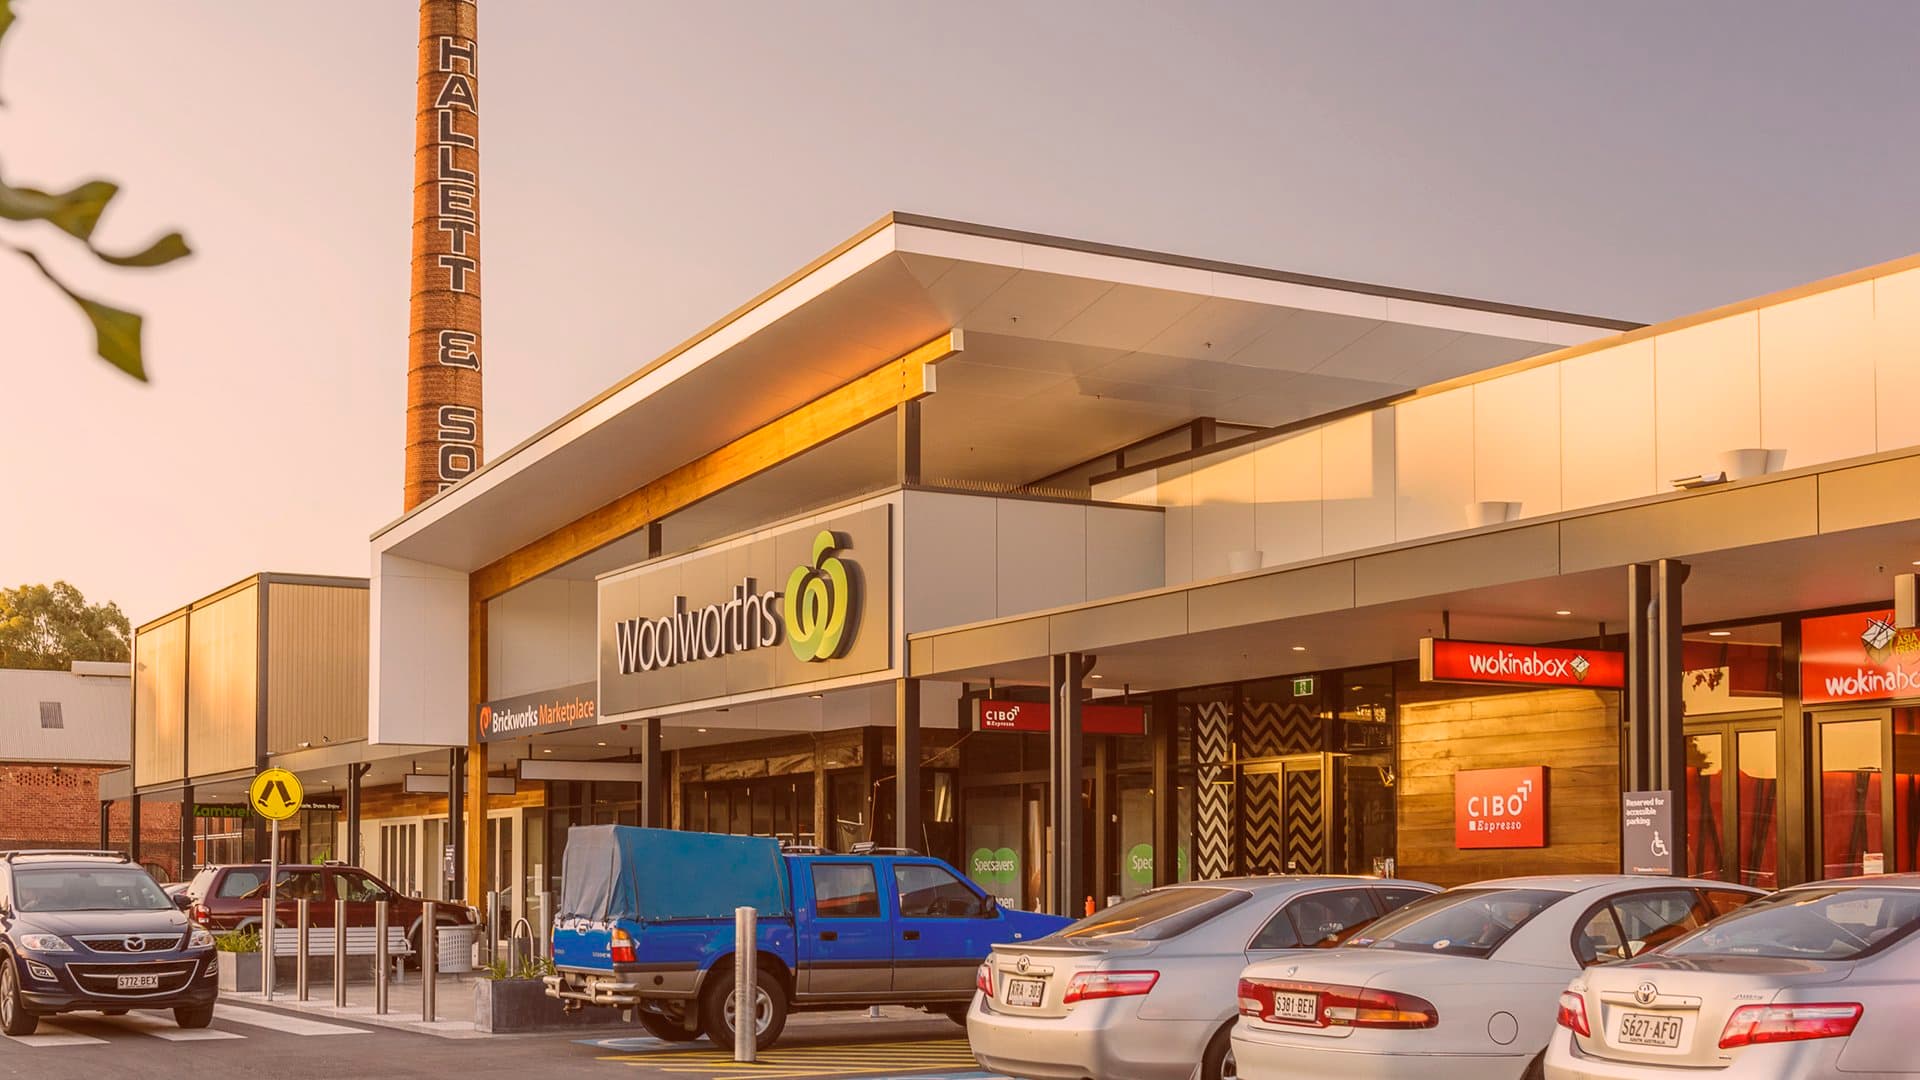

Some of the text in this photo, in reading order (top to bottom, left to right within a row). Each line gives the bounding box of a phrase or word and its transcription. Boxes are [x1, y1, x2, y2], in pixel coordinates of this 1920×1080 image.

[435, 36, 480, 494] HALLETT & SO
[615, 576, 777, 675] woolworths
[1897, 632, 1918, 645] ASIA
[1469, 649, 1569, 678] wokinabox
[492, 696, 595, 733] Brickworks Marketplace
[986, 710, 1015, 721] CIBO
[1468, 794, 1523, 817] CIBO
[1626, 798, 1664, 806] Reserved for
[1626, 807, 1656, 816] accessible
[1477, 820, 1521, 833] Espresso
[1626, 817, 1651, 827] parking
[975, 857, 1015, 874] Specsavers
